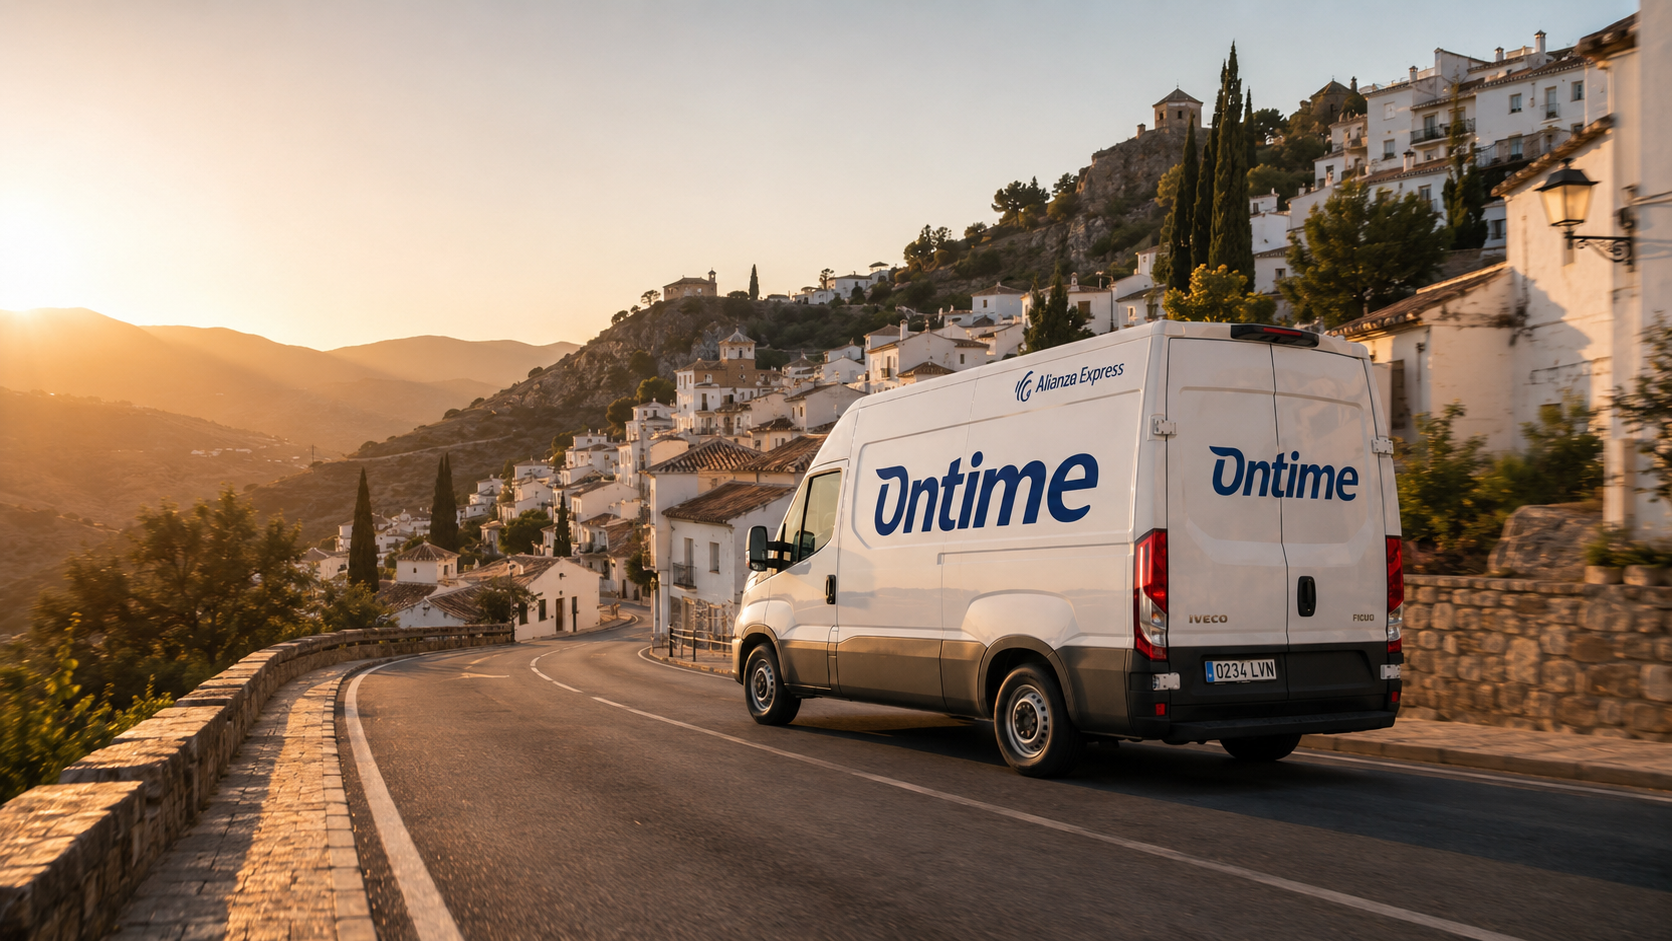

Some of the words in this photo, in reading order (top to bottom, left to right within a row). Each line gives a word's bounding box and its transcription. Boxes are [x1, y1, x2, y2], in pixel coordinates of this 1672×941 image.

[1035, 373, 1078, 393] Alianza
[1079, 363, 1125, 386] Express
[1210, 445, 1359, 502] Ontime
[875, 451, 1099, 536] Ontime
[1188, 614, 1229, 624] IVECO
[1216, 662, 1247, 679] 0234
[1250, 661, 1275, 678] LVN
